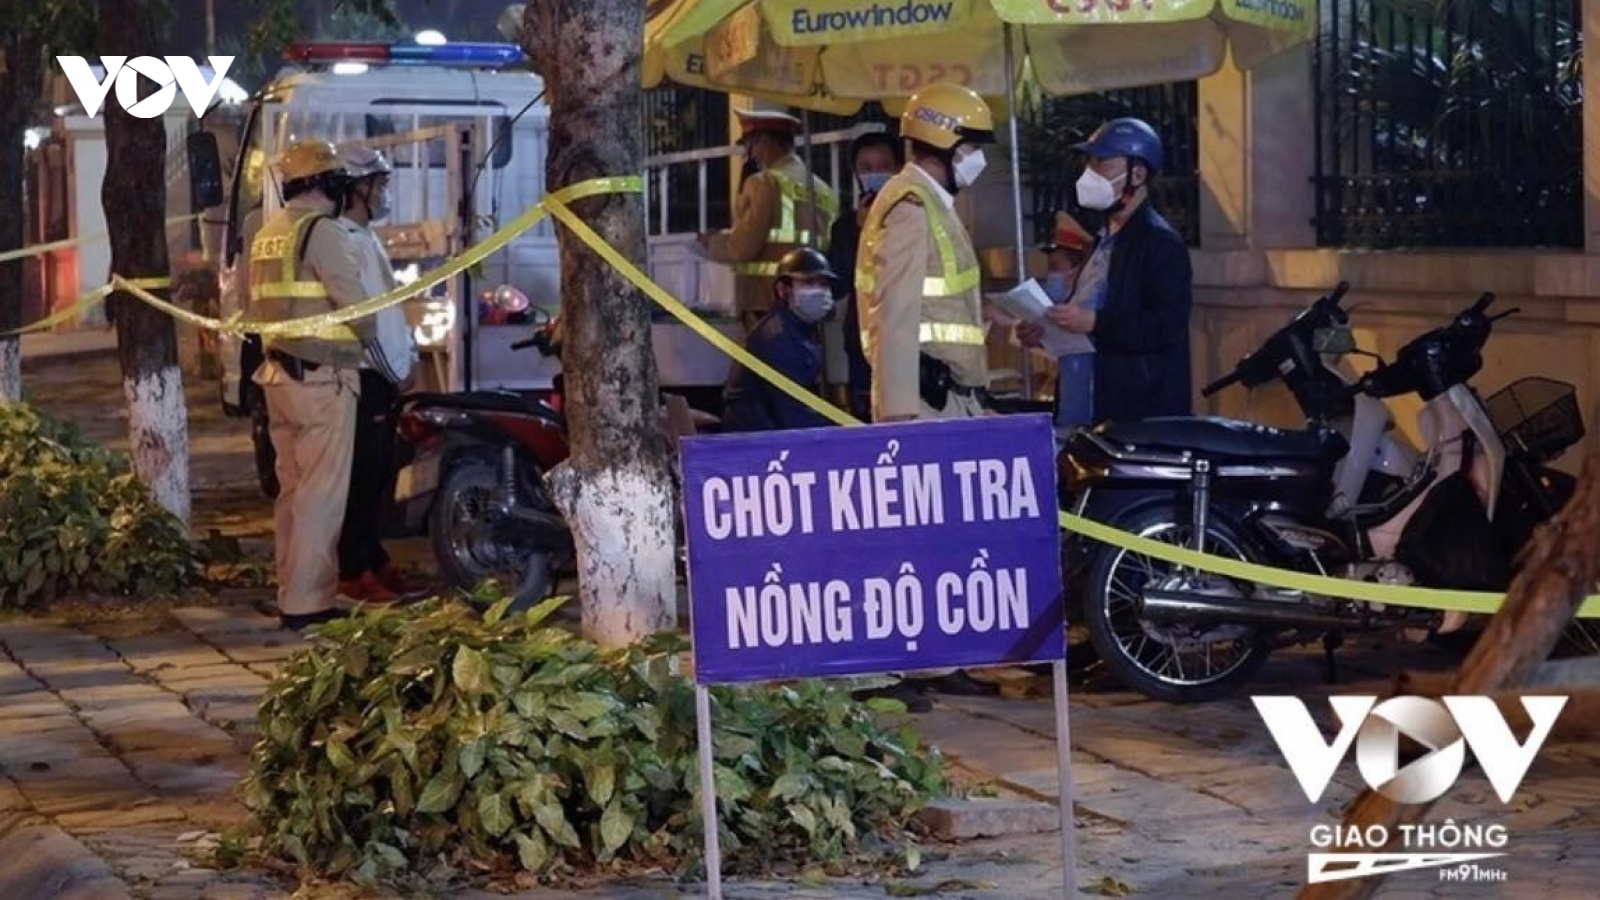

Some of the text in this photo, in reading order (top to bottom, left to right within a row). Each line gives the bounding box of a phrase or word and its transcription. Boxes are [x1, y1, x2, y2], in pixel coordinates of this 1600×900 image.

[792, 2, 952, 34] Eurowindow
[702, 439, 1040, 540] CHỐT KIỂM TRA
[725, 548, 1030, 651] NỒNG ĐỘ CỒN
